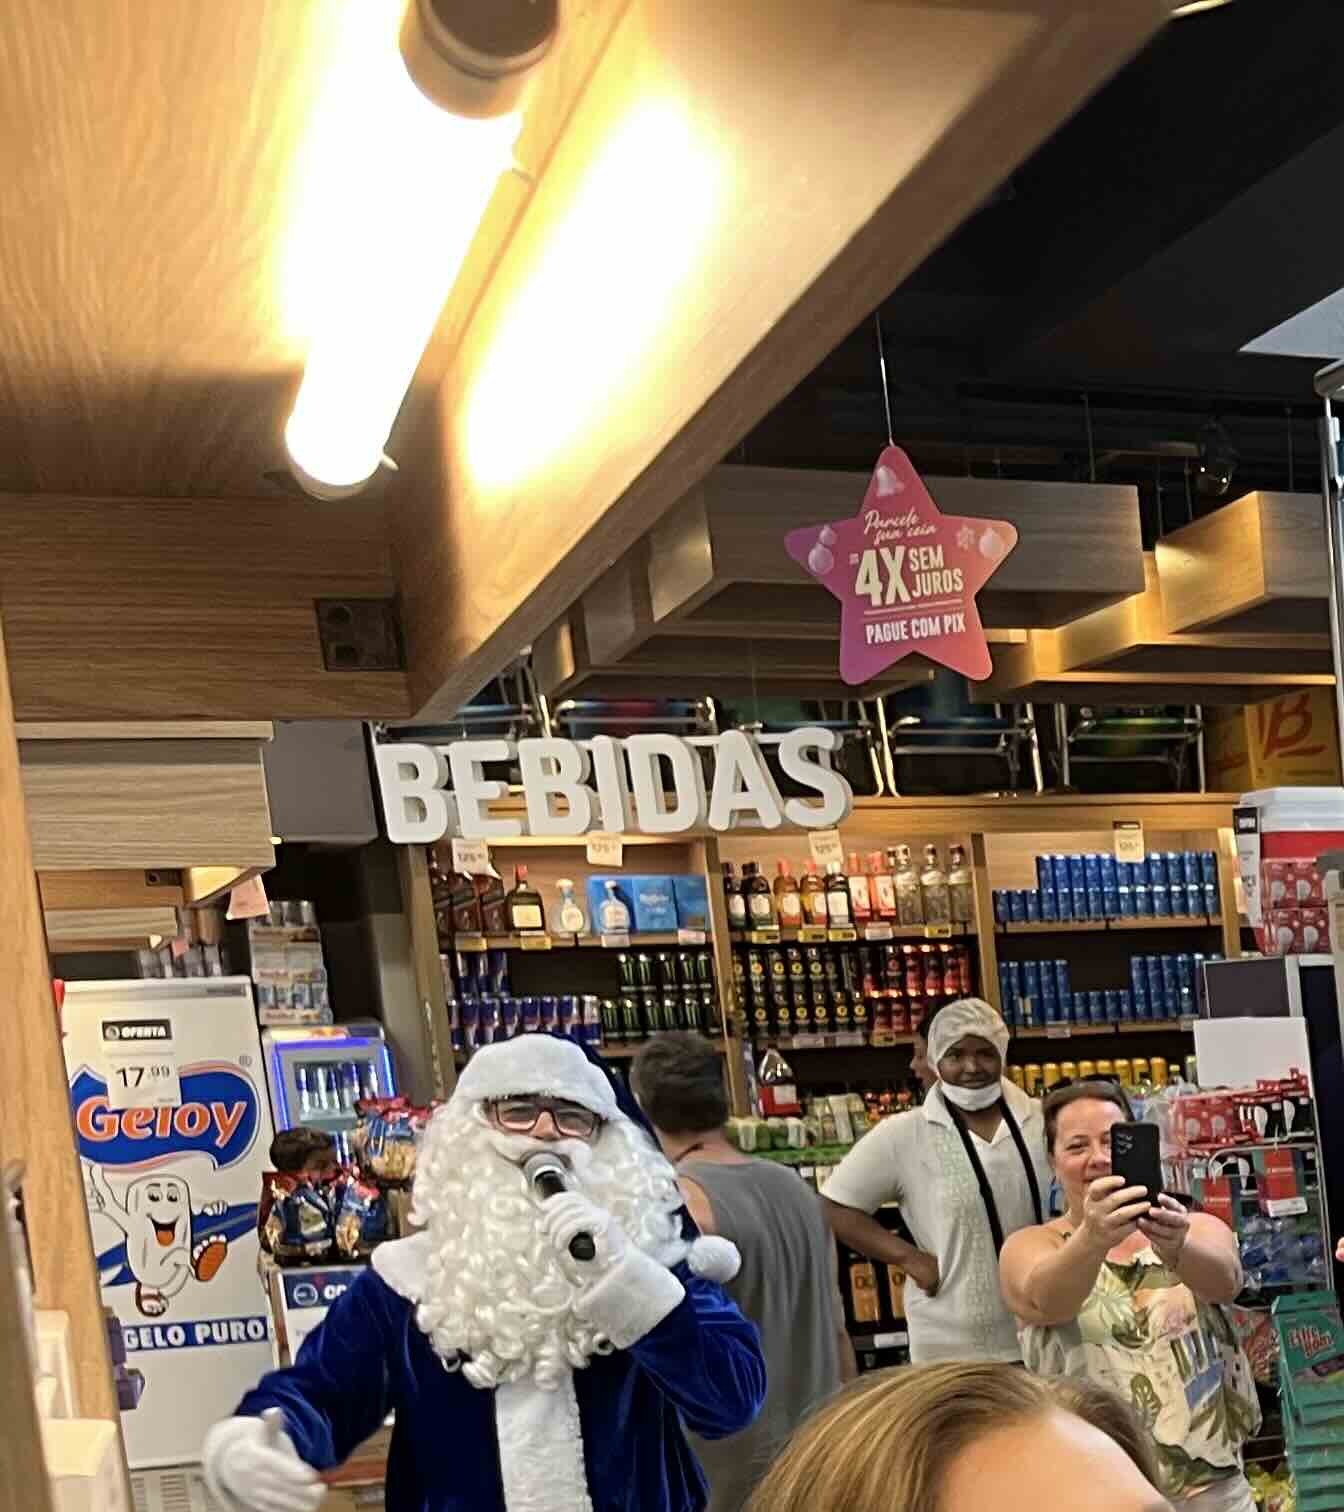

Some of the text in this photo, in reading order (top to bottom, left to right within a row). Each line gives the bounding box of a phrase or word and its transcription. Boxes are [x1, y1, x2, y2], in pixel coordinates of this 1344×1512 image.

[855, 544, 944, 607] 4X SEM
[911, 567, 964, 599] JUROS
[865, 611, 967, 645] PAGUE COM PIX
[374, 726, 854, 845] BEBIDAS
[124, 1318, 266, 1349] GELO PURO
